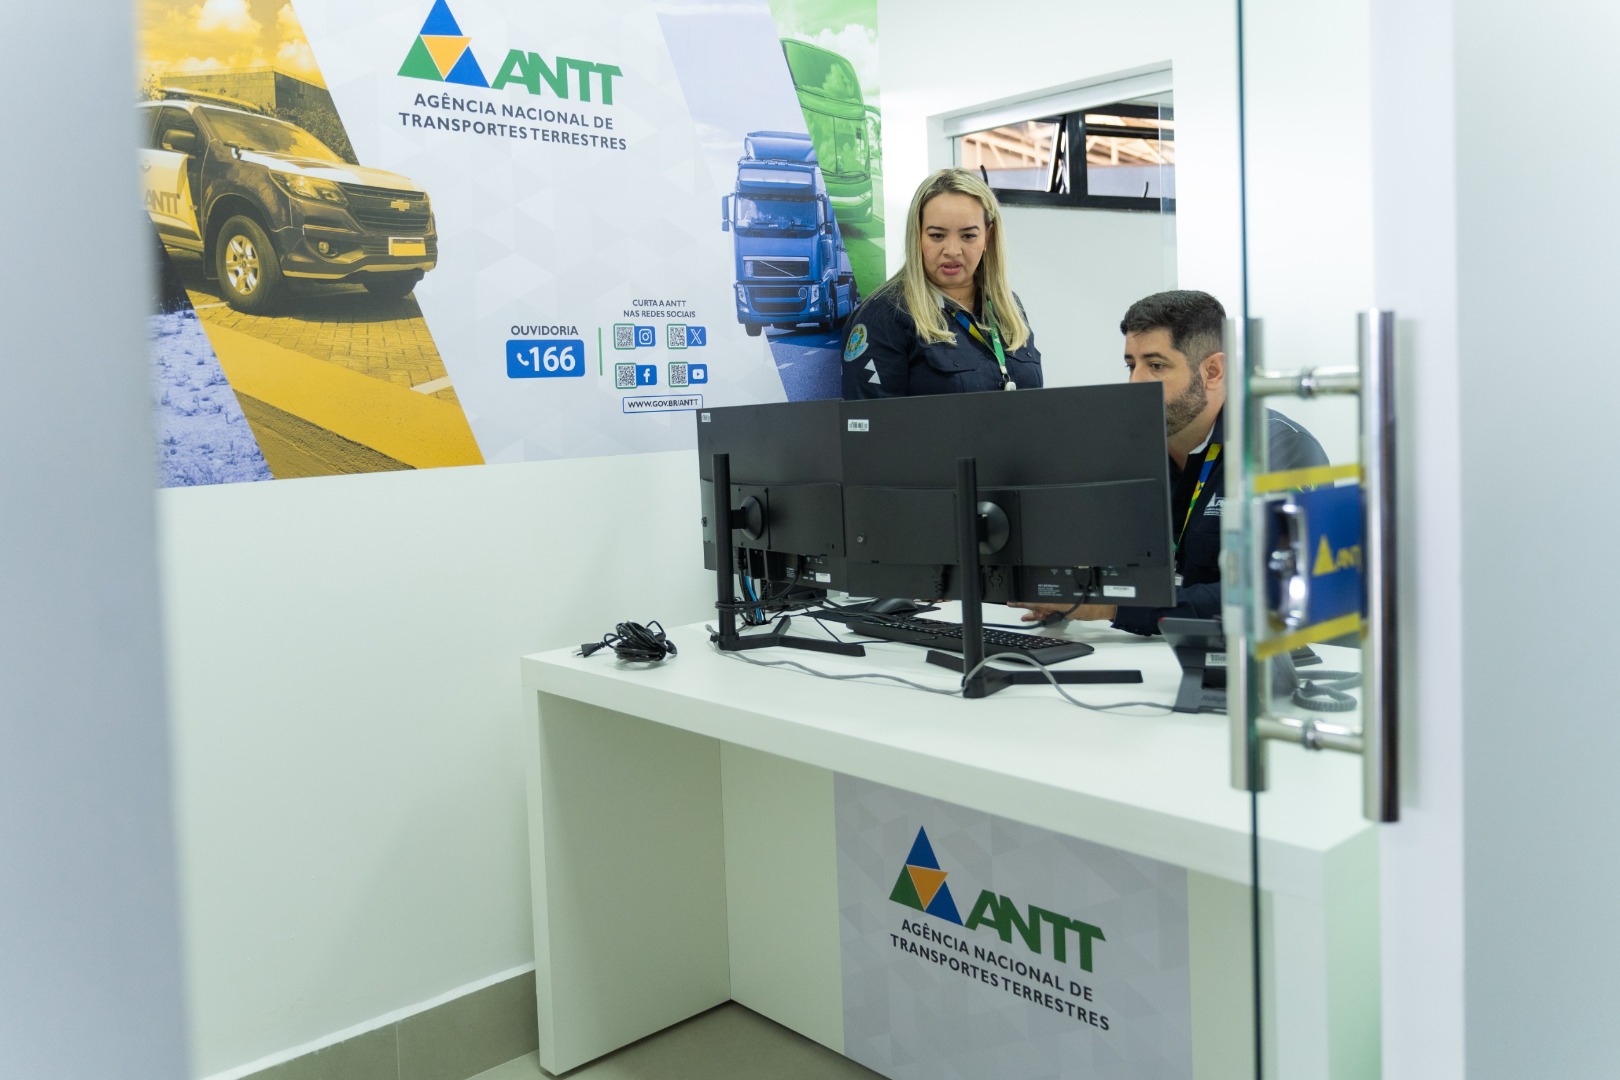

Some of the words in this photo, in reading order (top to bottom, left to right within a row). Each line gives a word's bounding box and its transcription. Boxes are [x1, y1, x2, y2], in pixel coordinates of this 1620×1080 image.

[490, 48, 624, 106] ANTT
[413, 93, 497, 116] AGÊNCIA
[502, 103, 589, 127] NACIONAL
[594, 116, 613, 130] DE
[398, 112, 528, 139] TRANSPORTES
[530, 127, 627, 150] TERRESTRES
[623, 310, 640, 318] NAS
[641, 310, 665, 318] REDES
[666, 310, 696, 318] SOCIAIS
[632, 299, 658, 307] CURTA
[665, 300, 687, 308] ANTT
[511, 325, 579, 336] OUVIDORIA
[529, 346, 576, 372] 166
[627, 398, 699, 409] WWW.GOV.BR/ANTT
[964, 888, 1107, 974] ANTT
[901, 919, 970, 956] AGÊNCIA
[974, 945, 1065, 991] NACIONAL
[1069, 981, 1094, 1002] DE
[890, 933, 999, 988] TRANSPORTES
[1001, 976, 1110, 1031] TERRESTRES
